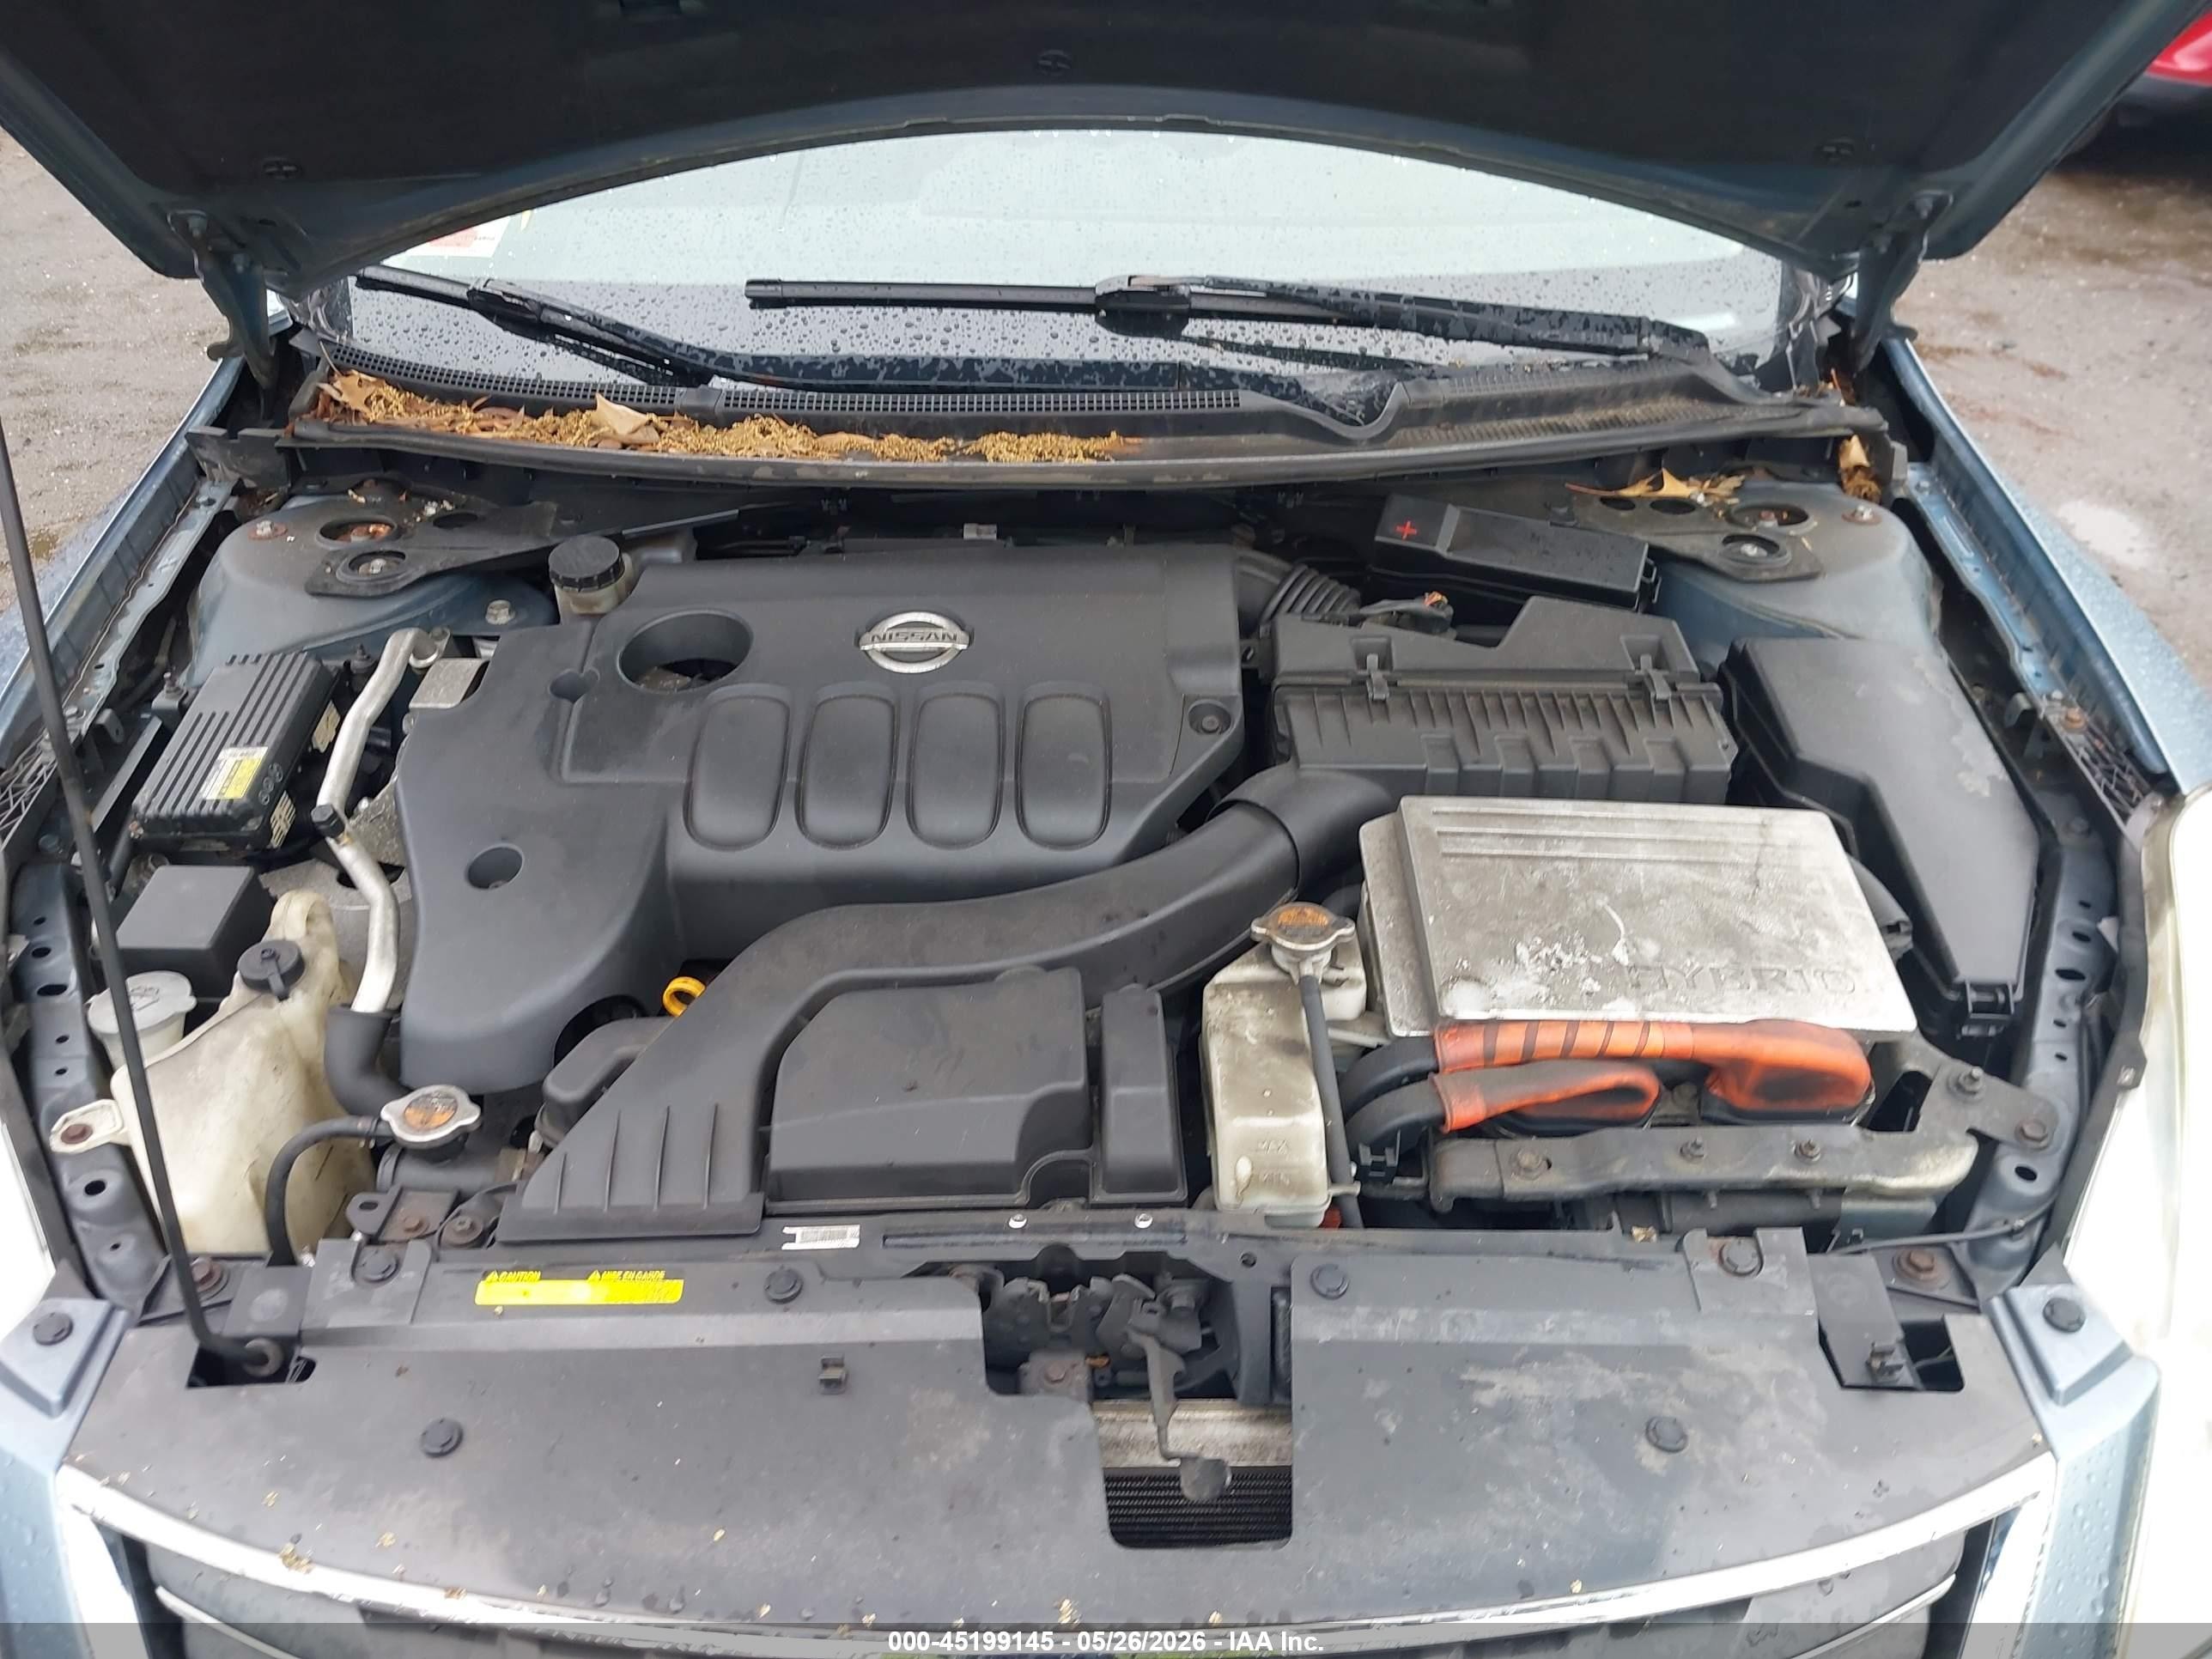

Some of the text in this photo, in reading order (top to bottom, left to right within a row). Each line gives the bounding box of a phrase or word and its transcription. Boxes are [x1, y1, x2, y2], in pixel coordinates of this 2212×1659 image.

[871, 631, 958, 642] NISSAN
[1625, 963, 1856, 994] HYBRID
[499, 1271, 542, 1282] CAUTION
